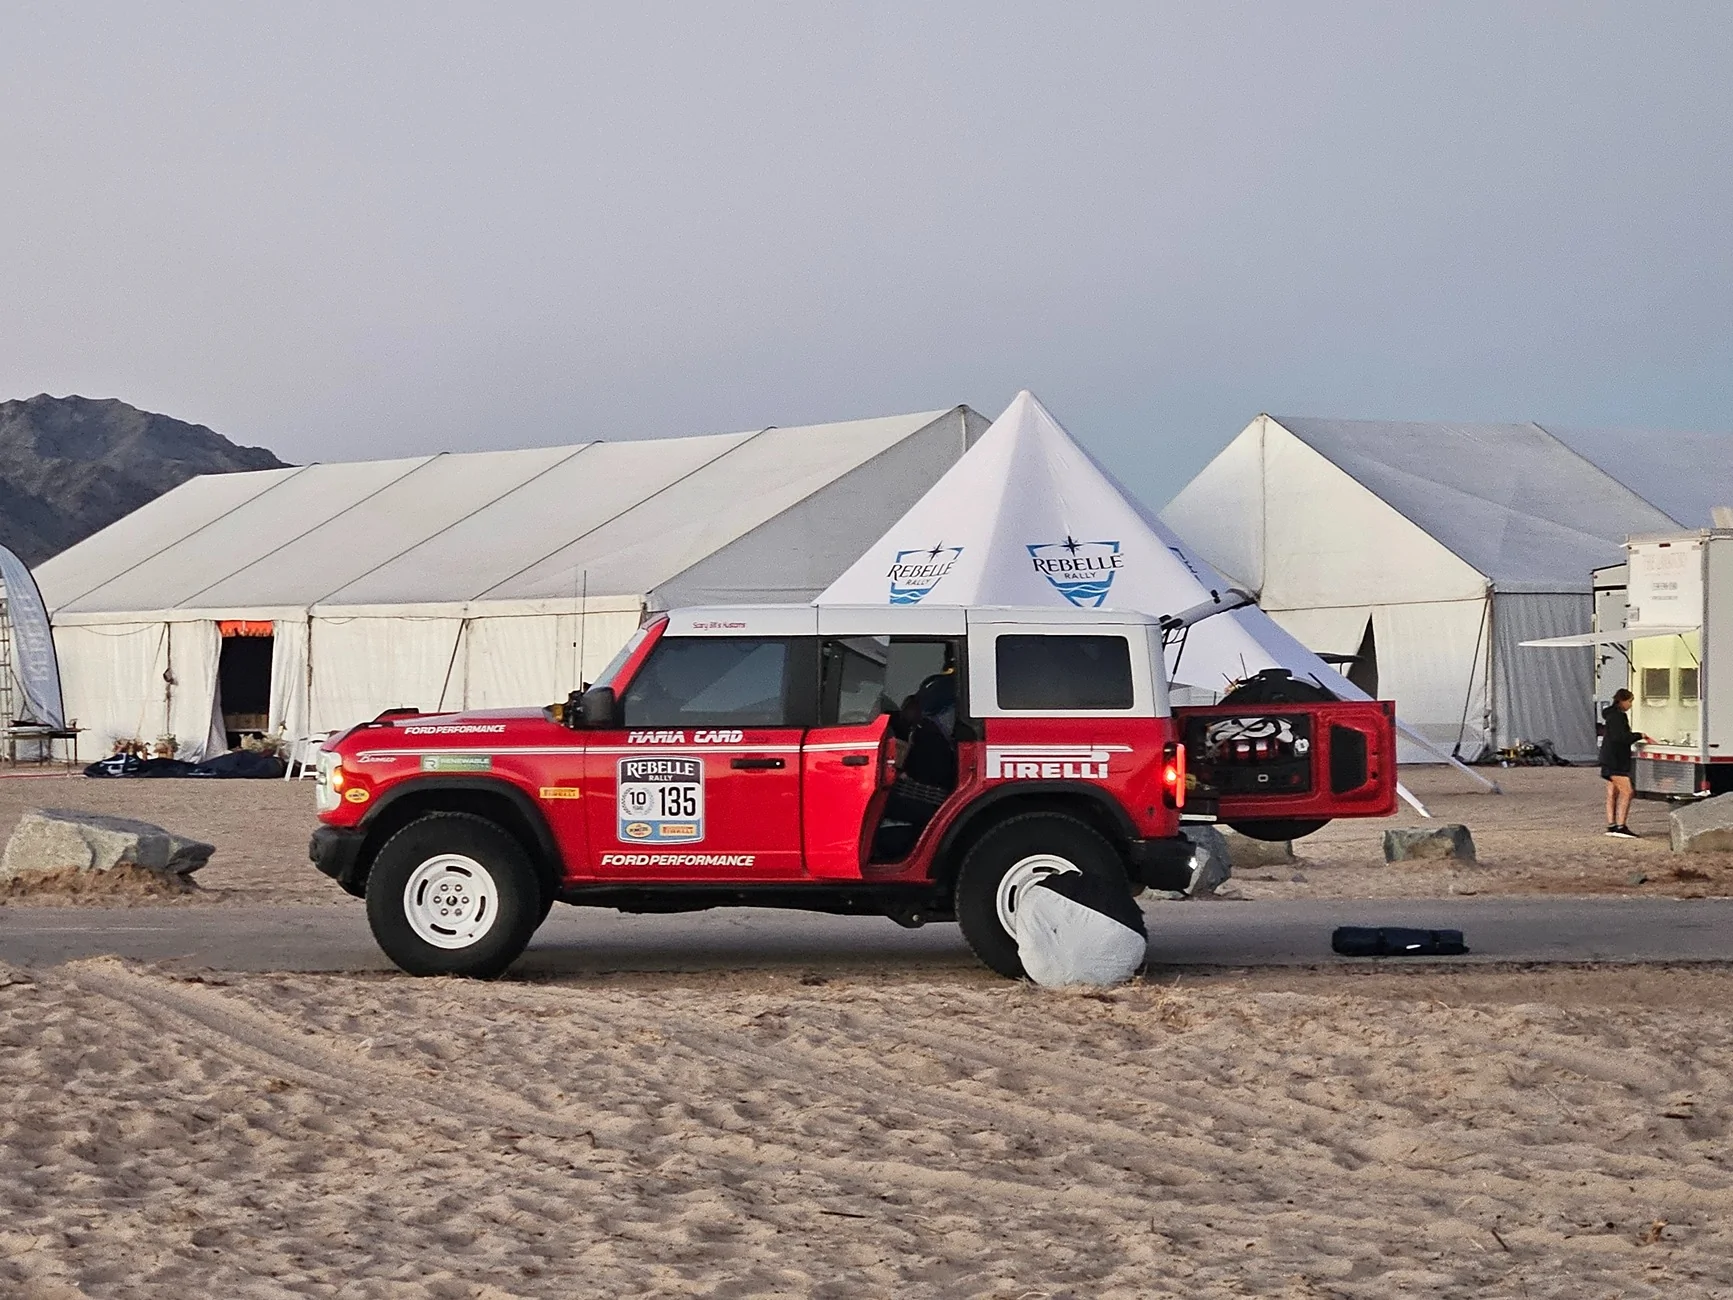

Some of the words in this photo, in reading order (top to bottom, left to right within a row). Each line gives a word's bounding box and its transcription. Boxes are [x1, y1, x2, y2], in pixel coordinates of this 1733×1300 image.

[887, 561, 955, 581] REBELLE
[1033, 553, 1124, 577] REBELLE
[905, 578, 930, 586] RALLY
[1064, 571, 1097, 579] RALLY
[627, 730, 686, 744] MARIA
[693, 729, 744, 743] CARD
[626, 761, 695, 778] REBELLE
[986, 747, 1112, 779] PIRELLI
[648, 774, 673, 782] RALLY
[629, 791, 647, 805] 10
[658, 786, 696, 817] 135
